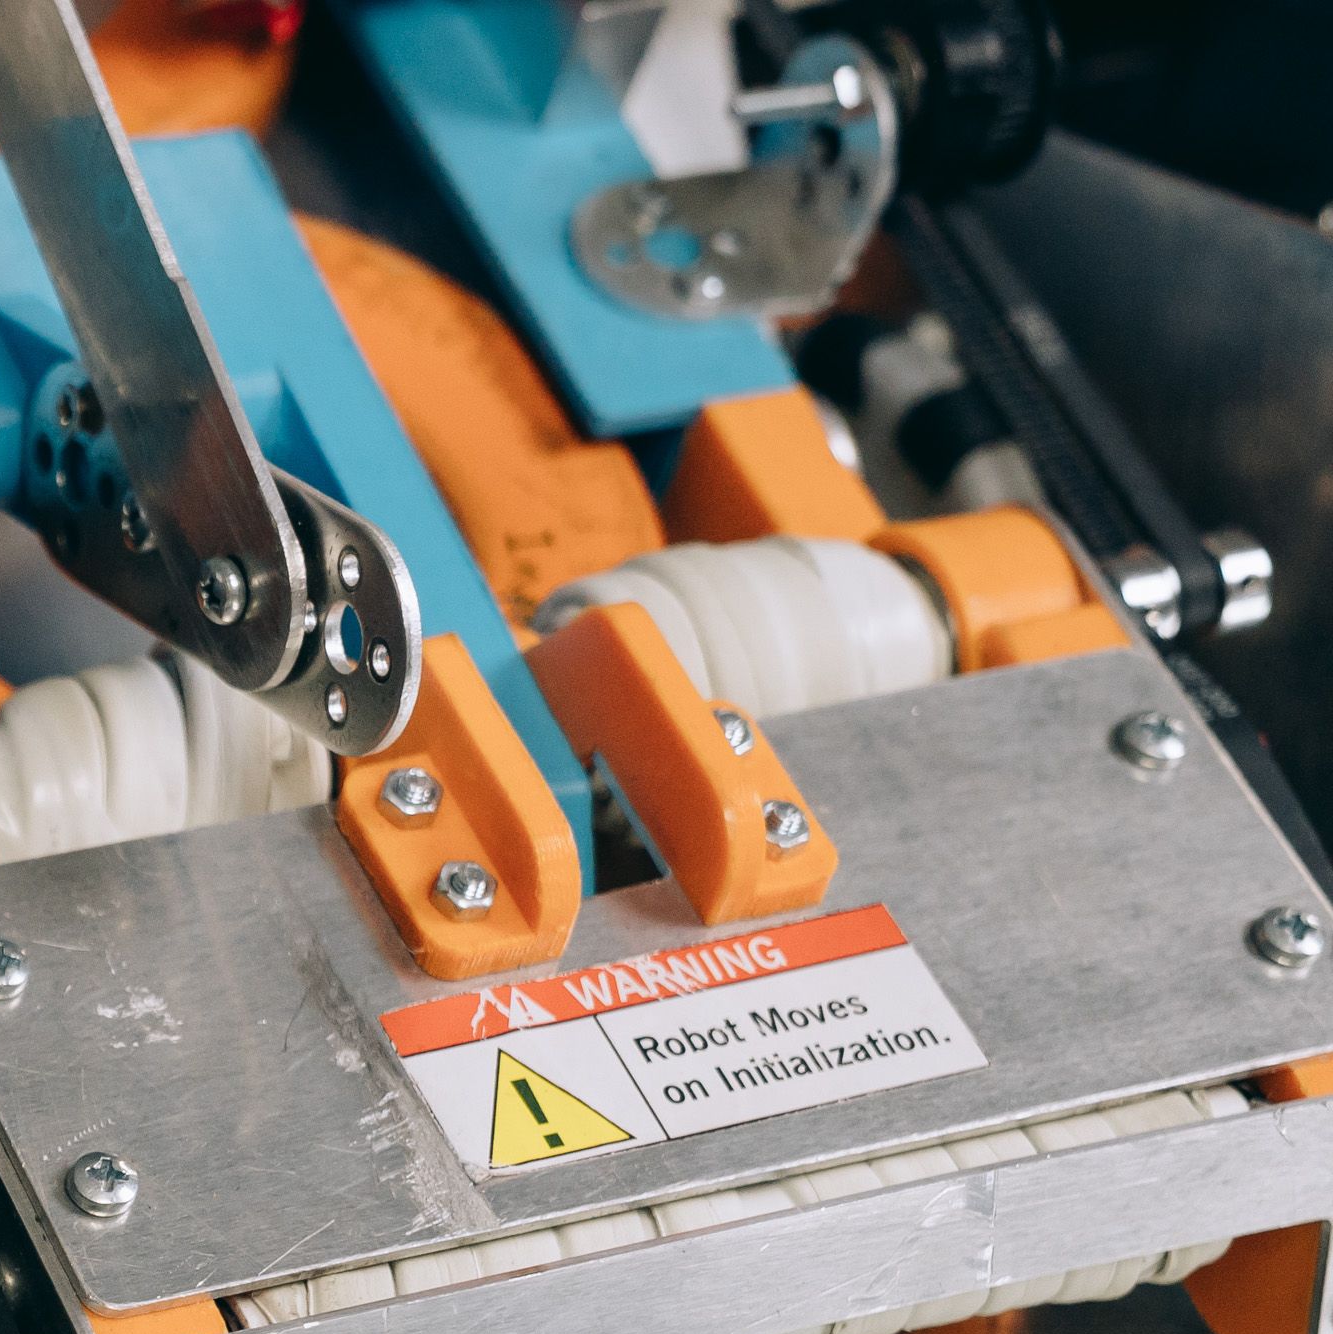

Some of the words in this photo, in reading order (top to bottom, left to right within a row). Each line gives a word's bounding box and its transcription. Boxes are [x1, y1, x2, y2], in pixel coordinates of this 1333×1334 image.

[562, 935, 788, 1011] WARNING
[633, 1018, 745, 1064] Robot
[749, 994, 869, 1038] Moves
[662, 1077, 711, 1104] on
[715, 1022, 952, 1092] Initialization.
